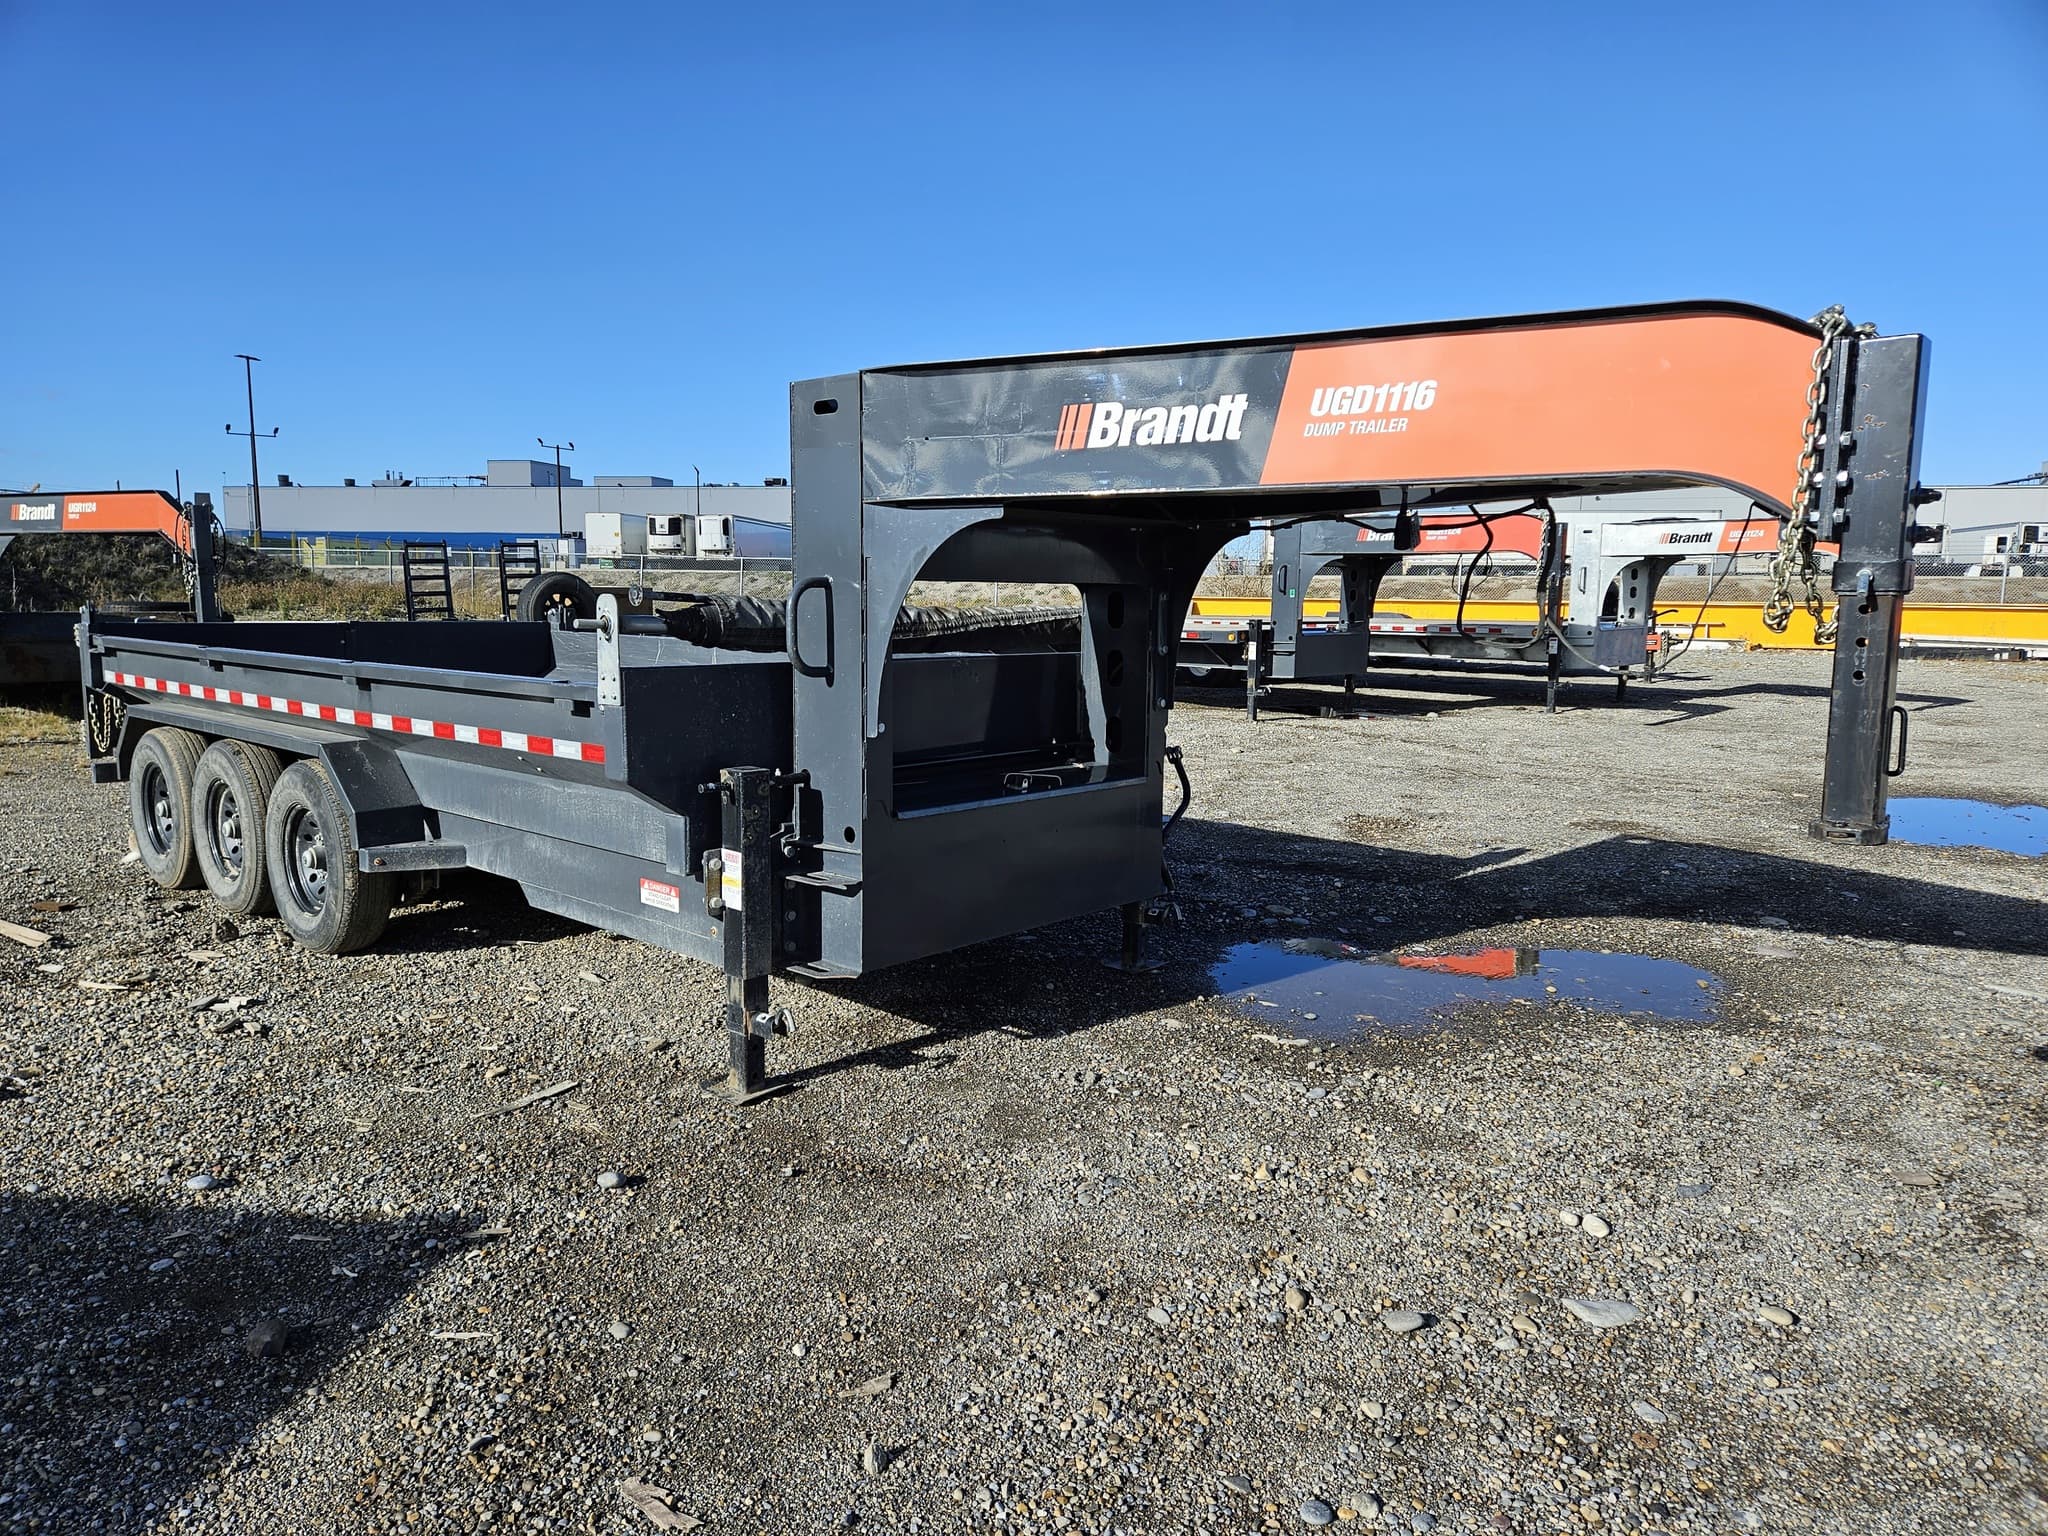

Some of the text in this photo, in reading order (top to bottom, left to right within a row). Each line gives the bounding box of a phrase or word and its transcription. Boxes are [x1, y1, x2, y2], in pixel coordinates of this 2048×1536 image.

[1310, 380, 1437, 416] UGD1116
[1086, 393, 1249, 449] Brandt
[1304, 417, 1408, 438] DUMP TRAILER
[19, 503, 55, 520] Brandt
[1669, 532, 1712, 544] Brandt
